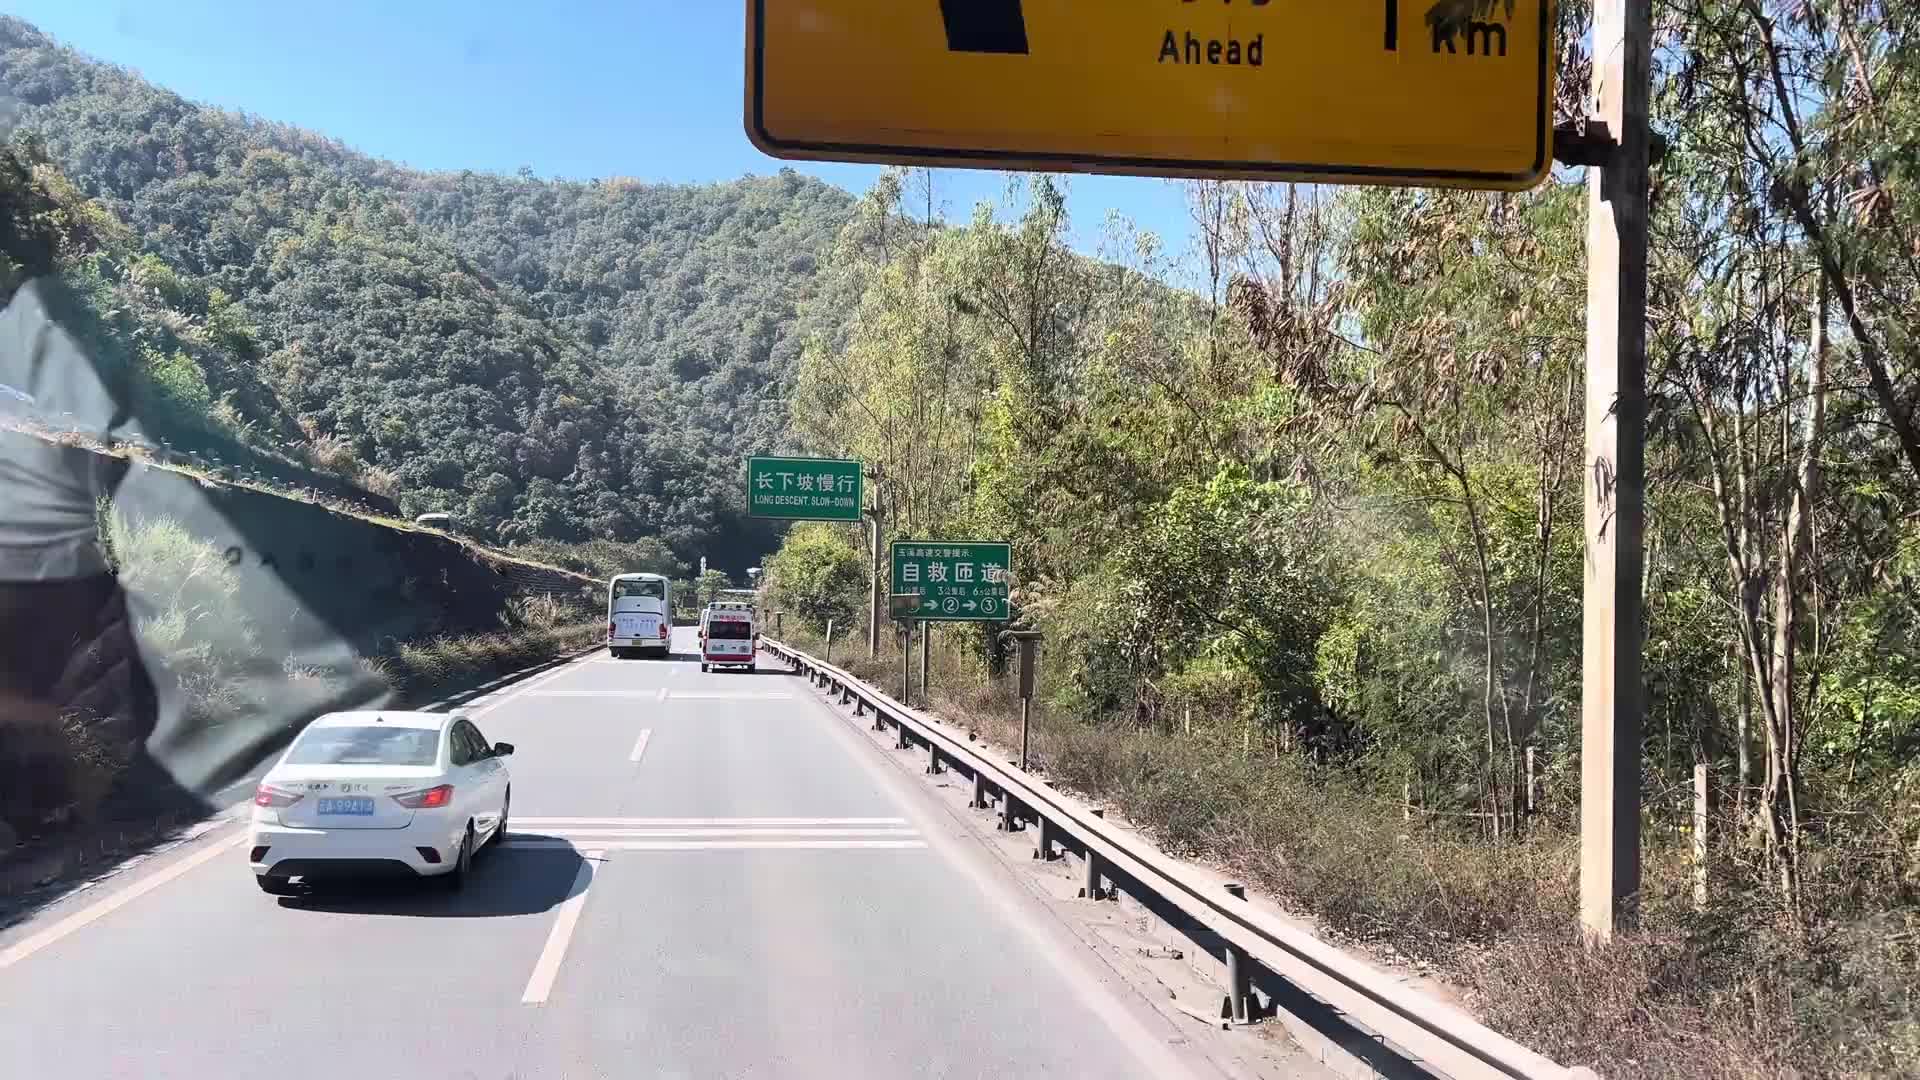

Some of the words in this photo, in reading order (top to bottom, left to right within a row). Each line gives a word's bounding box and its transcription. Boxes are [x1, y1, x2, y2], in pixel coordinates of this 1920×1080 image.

[1158, 28, 1264, 66] Ahead
[755, 471, 855, 493] 长下坡慢行
[754, 495, 774, 505] LONG
[903, 561, 1003, 583] 自救匝道
